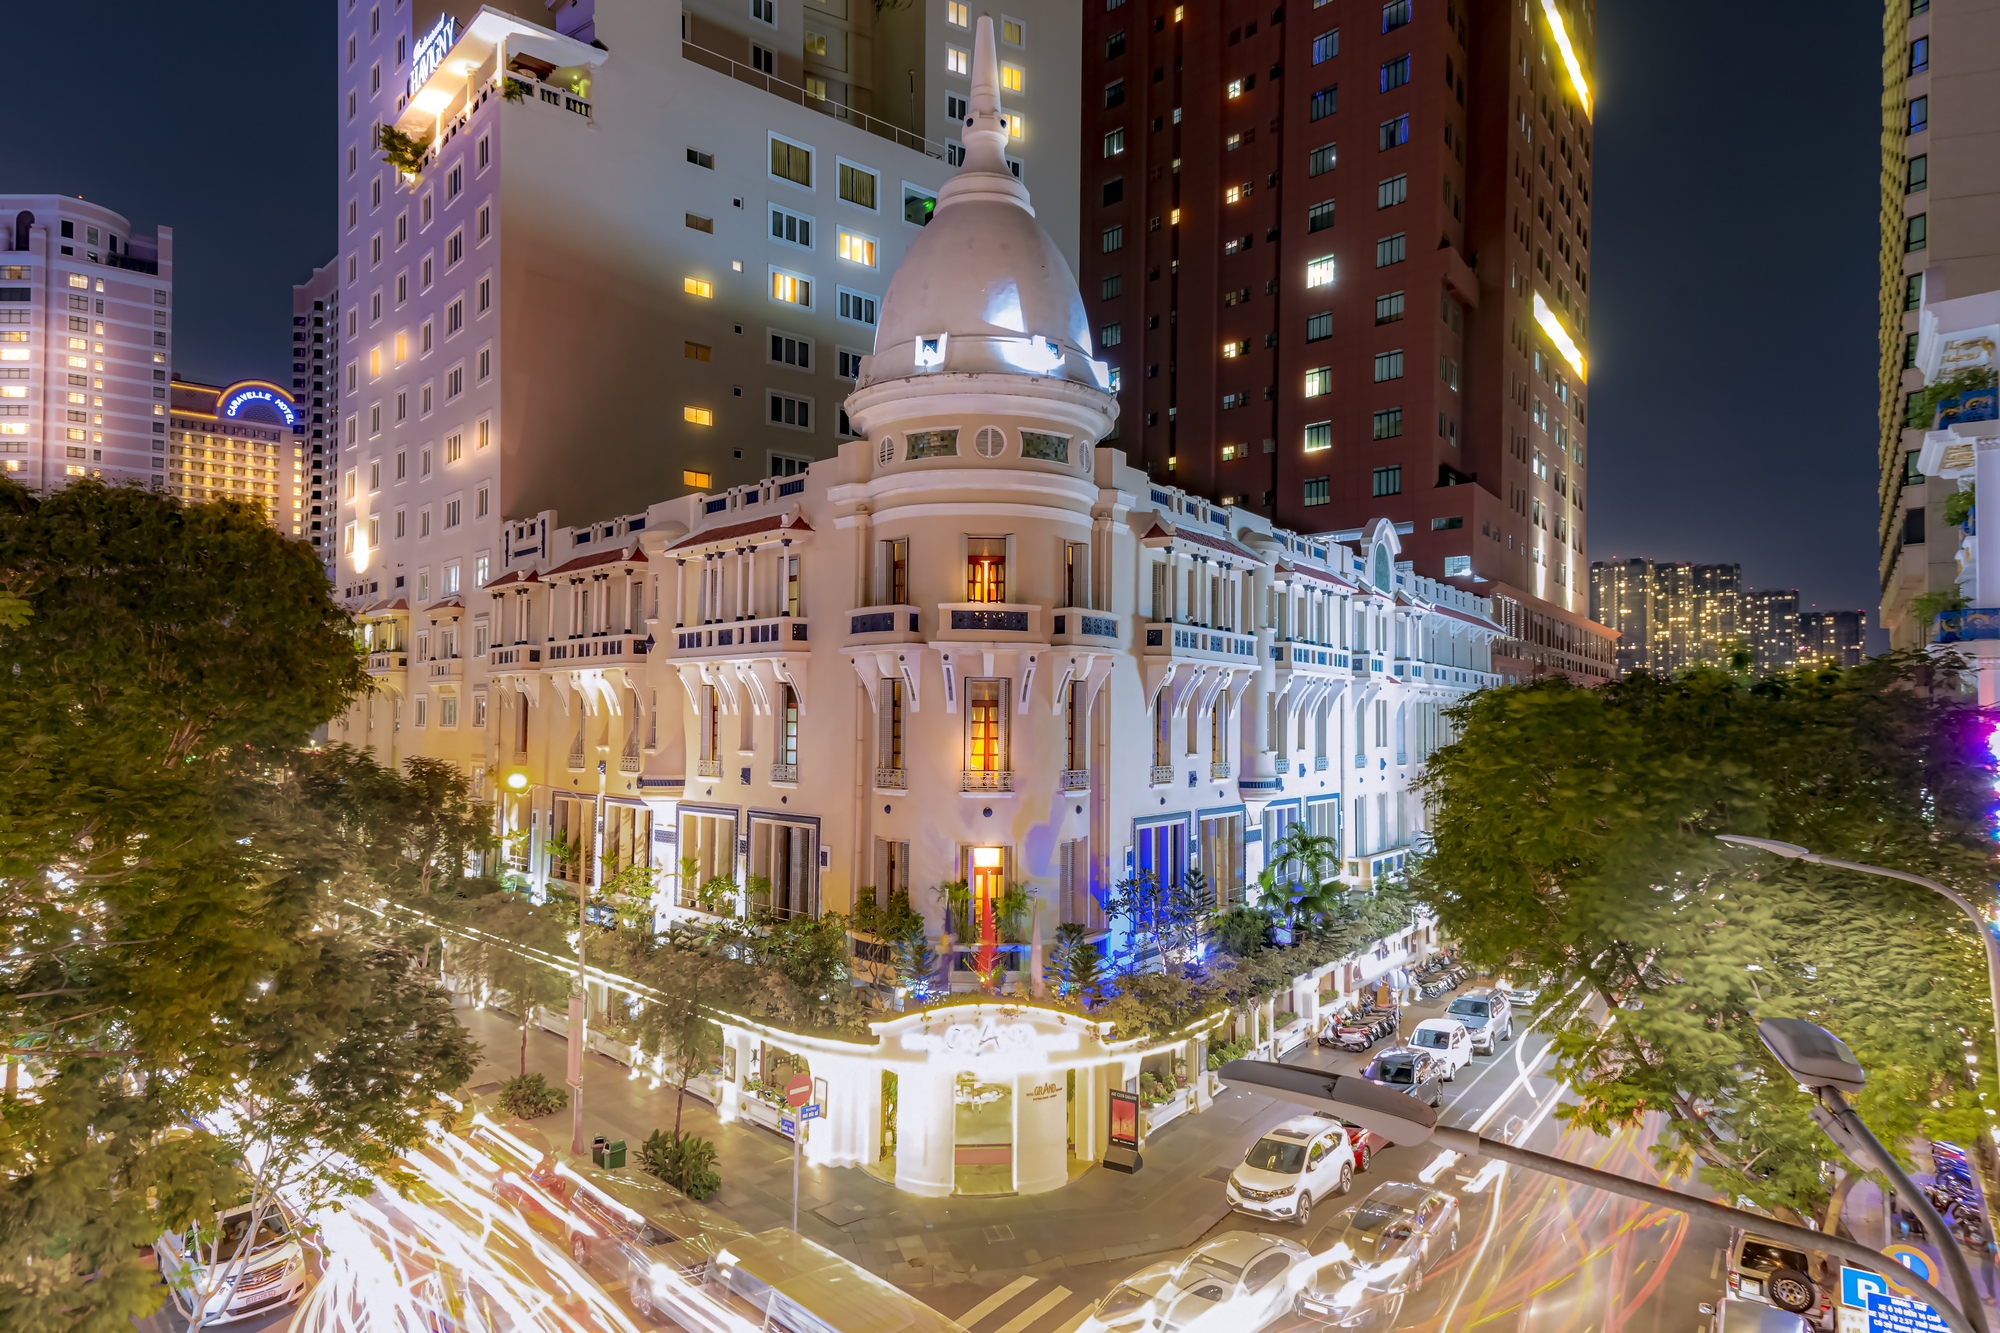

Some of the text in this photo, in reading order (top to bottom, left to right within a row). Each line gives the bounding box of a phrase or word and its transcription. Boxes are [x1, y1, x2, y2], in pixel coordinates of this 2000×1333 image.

[227, 391, 295, 425] CARAVELLE HOTEL
[1034, 1082, 1057, 1096] GRAND
[1857, 1278, 1880, 1301] P
